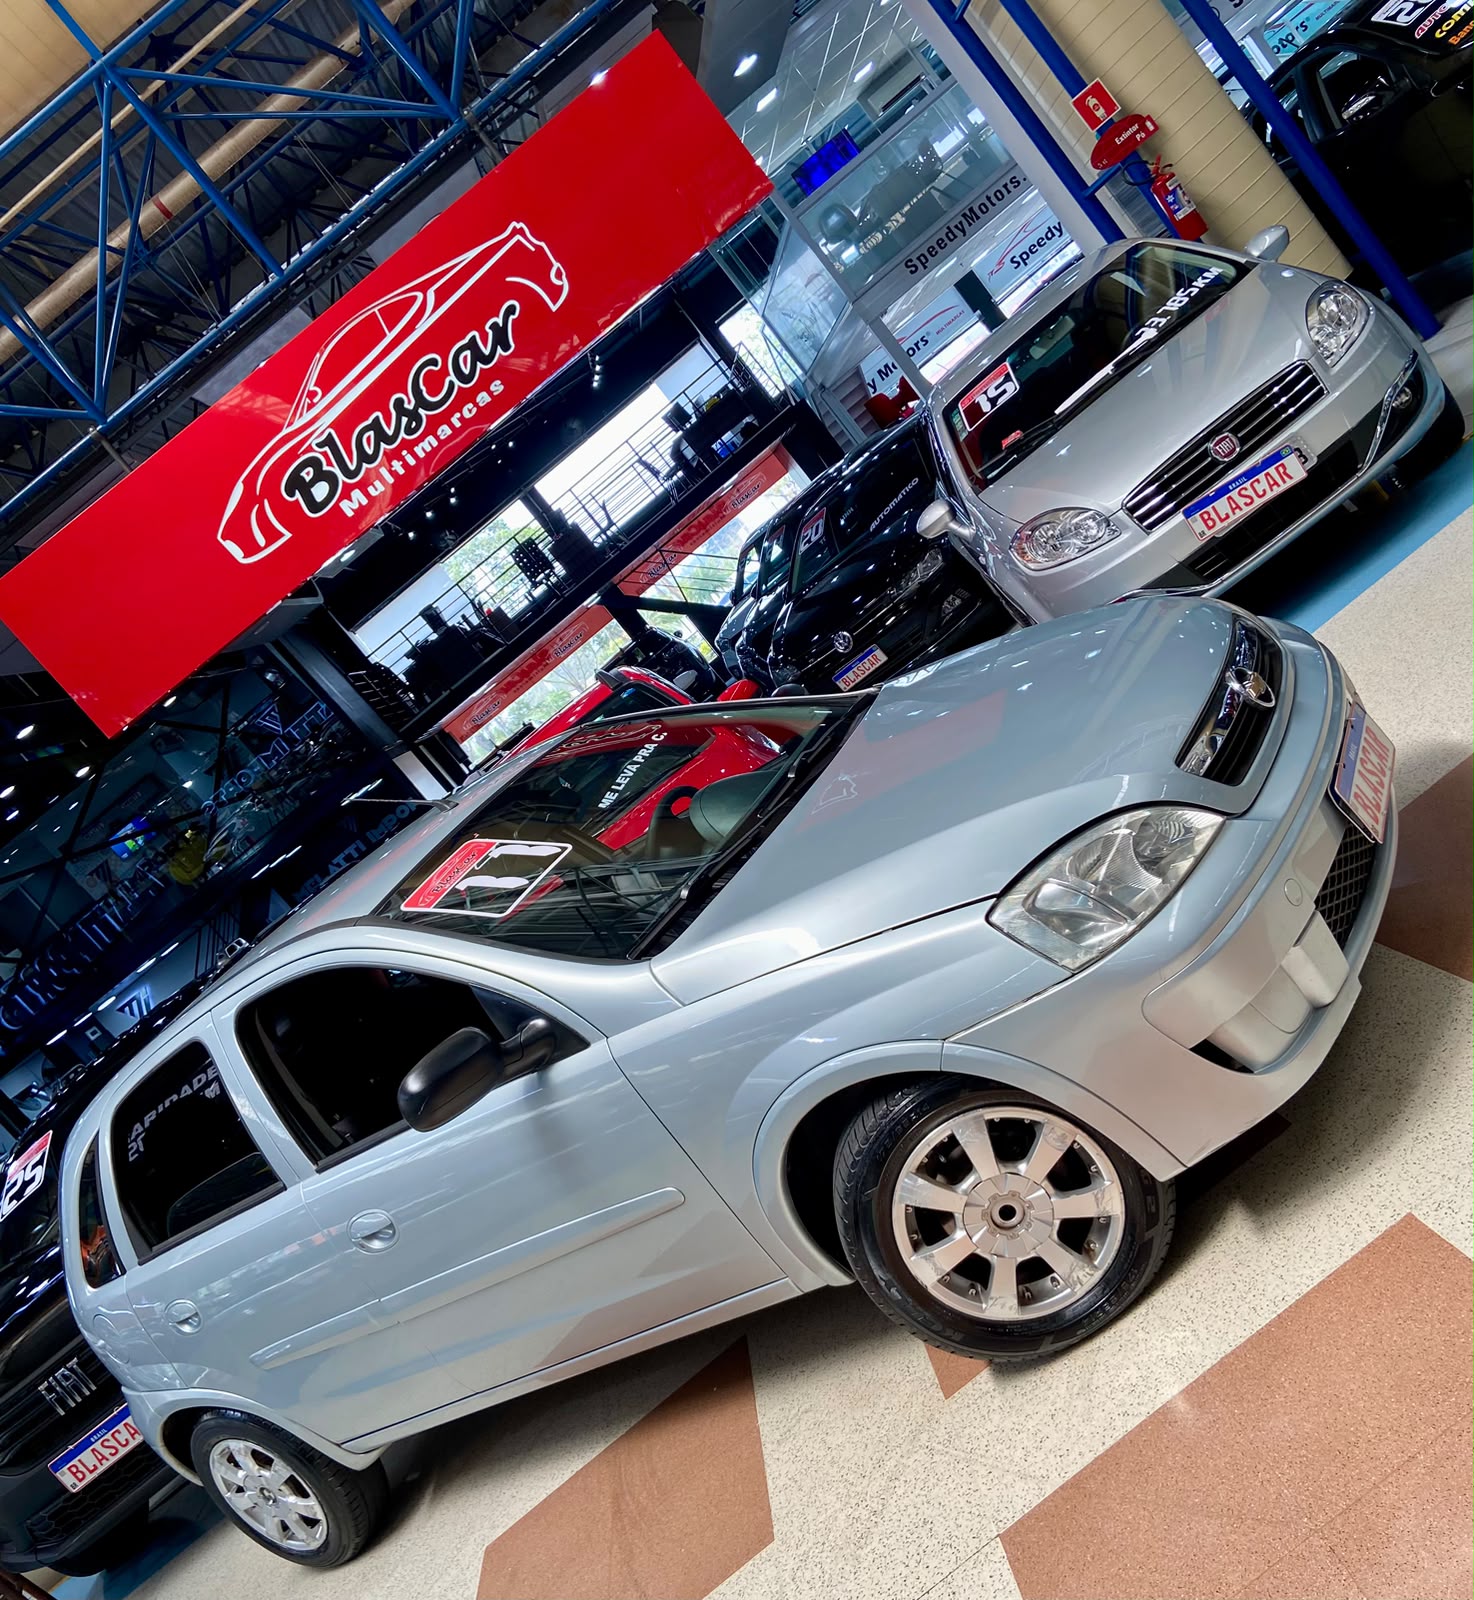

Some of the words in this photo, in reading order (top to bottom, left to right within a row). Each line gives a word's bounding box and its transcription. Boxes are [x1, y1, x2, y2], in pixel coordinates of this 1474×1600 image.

[1115, 123, 1140, 145] Extintor
[1009, 221, 1064, 270] Speedy
[282, 301, 519, 516] BlasCar
[339, 379, 504, 517] Multimarcas
[1215, 438, 1235, 457] FIAT
[1199, 462, 1293, 531] BLASCAR
[841, 653, 882, 688] BLASCAR
[598, 791, 619, 808] ME
[611, 764, 640, 790] LEVA
[633, 743, 658, 762] PRA
[1353, 725, 1390, 825] BLASCAR
[38, 1357, 97, 1416] FIAT
